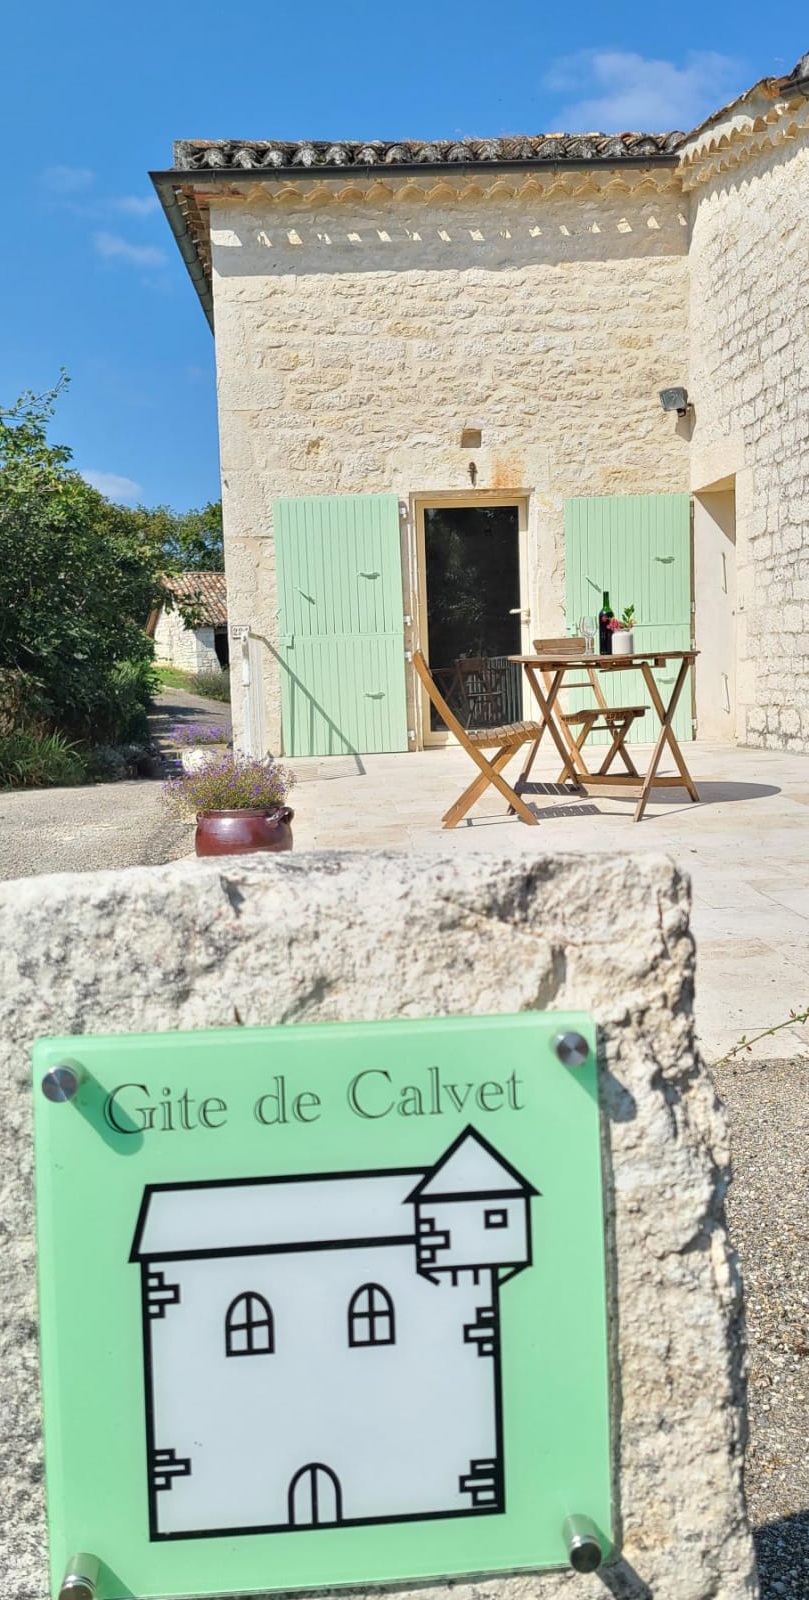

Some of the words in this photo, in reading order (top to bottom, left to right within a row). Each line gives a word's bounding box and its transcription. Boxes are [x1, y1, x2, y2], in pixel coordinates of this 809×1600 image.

[103, 1083, 228, 1134] Gite
[254, 1075, 322, 1125] de
[347, 1067, 526, 1119] Calvet
